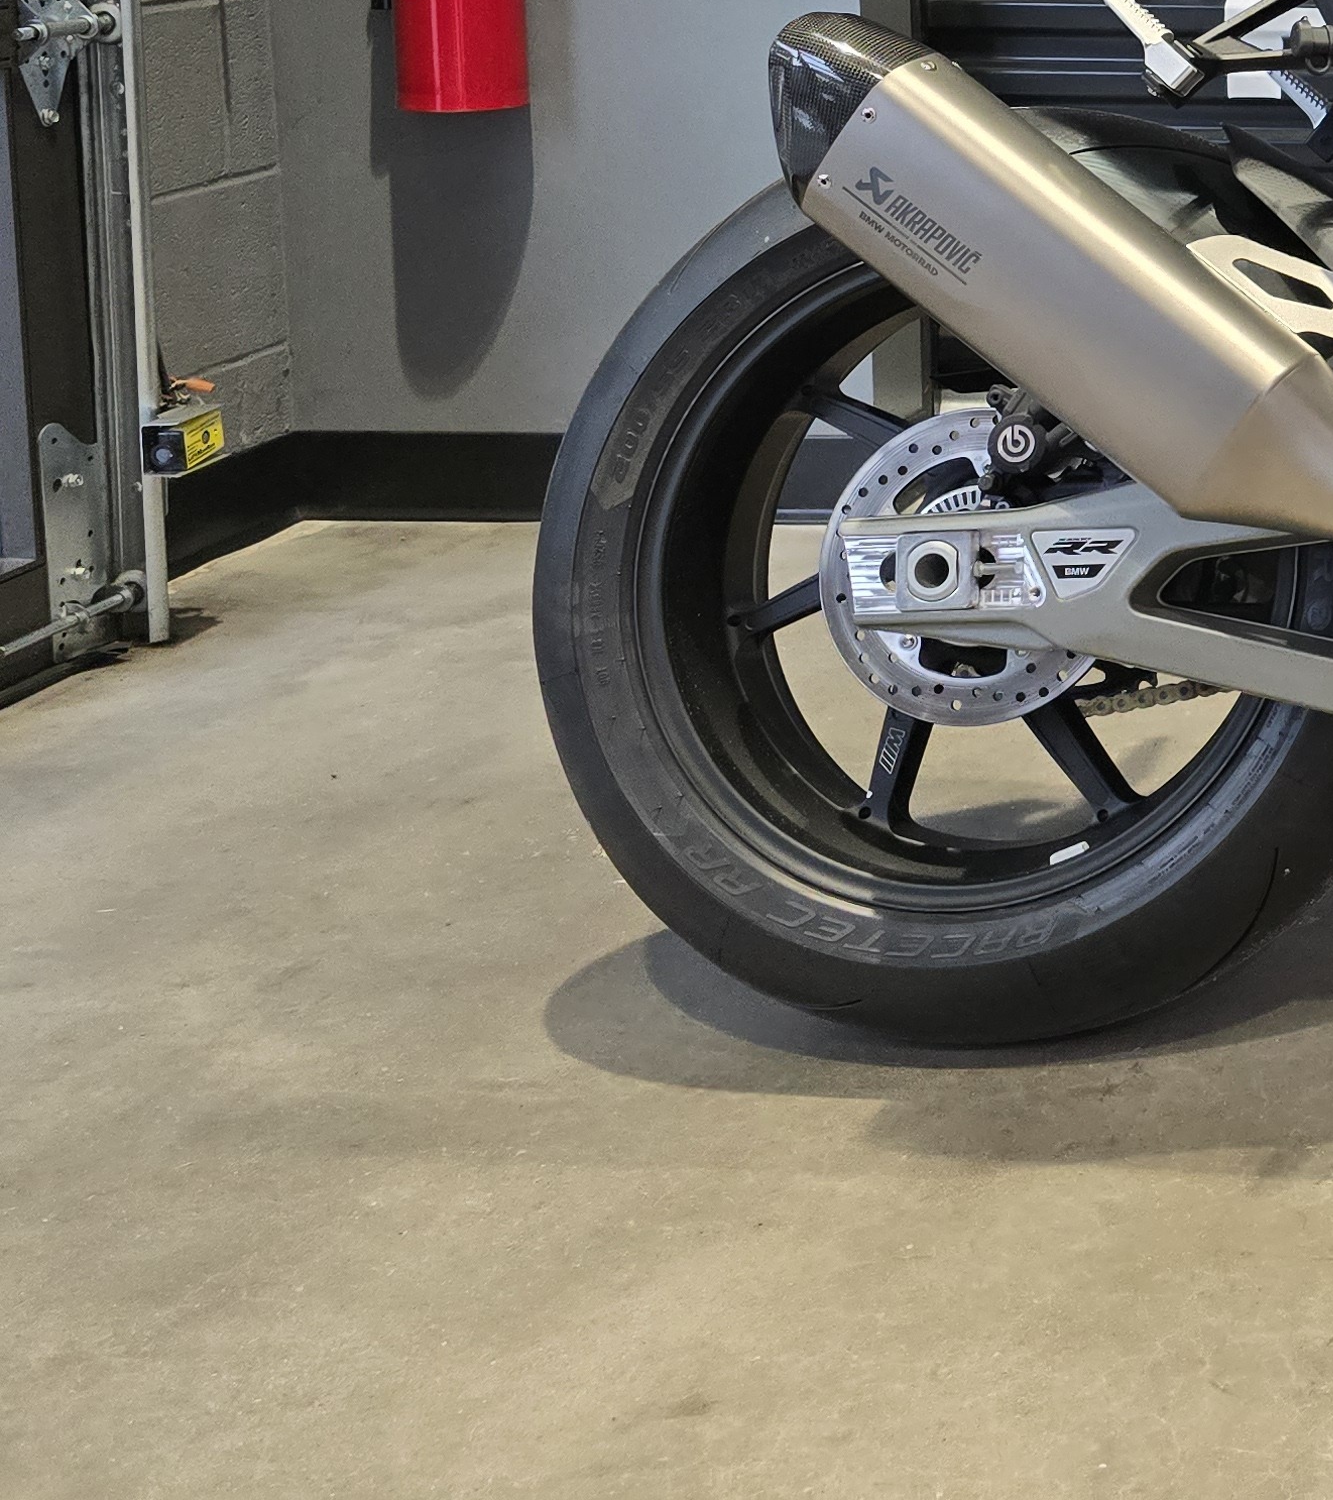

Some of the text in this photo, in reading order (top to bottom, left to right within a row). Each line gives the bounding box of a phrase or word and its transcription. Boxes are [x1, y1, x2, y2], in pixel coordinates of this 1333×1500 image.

[858, 211, 886, 234] BMW
[884, 231, 939, 277] MOTORRAD
[1043, 539, 1125, 556] RR
[1064, 566, 1090, 577] BMW
[766, 900, 1057, 961] RACETEC
